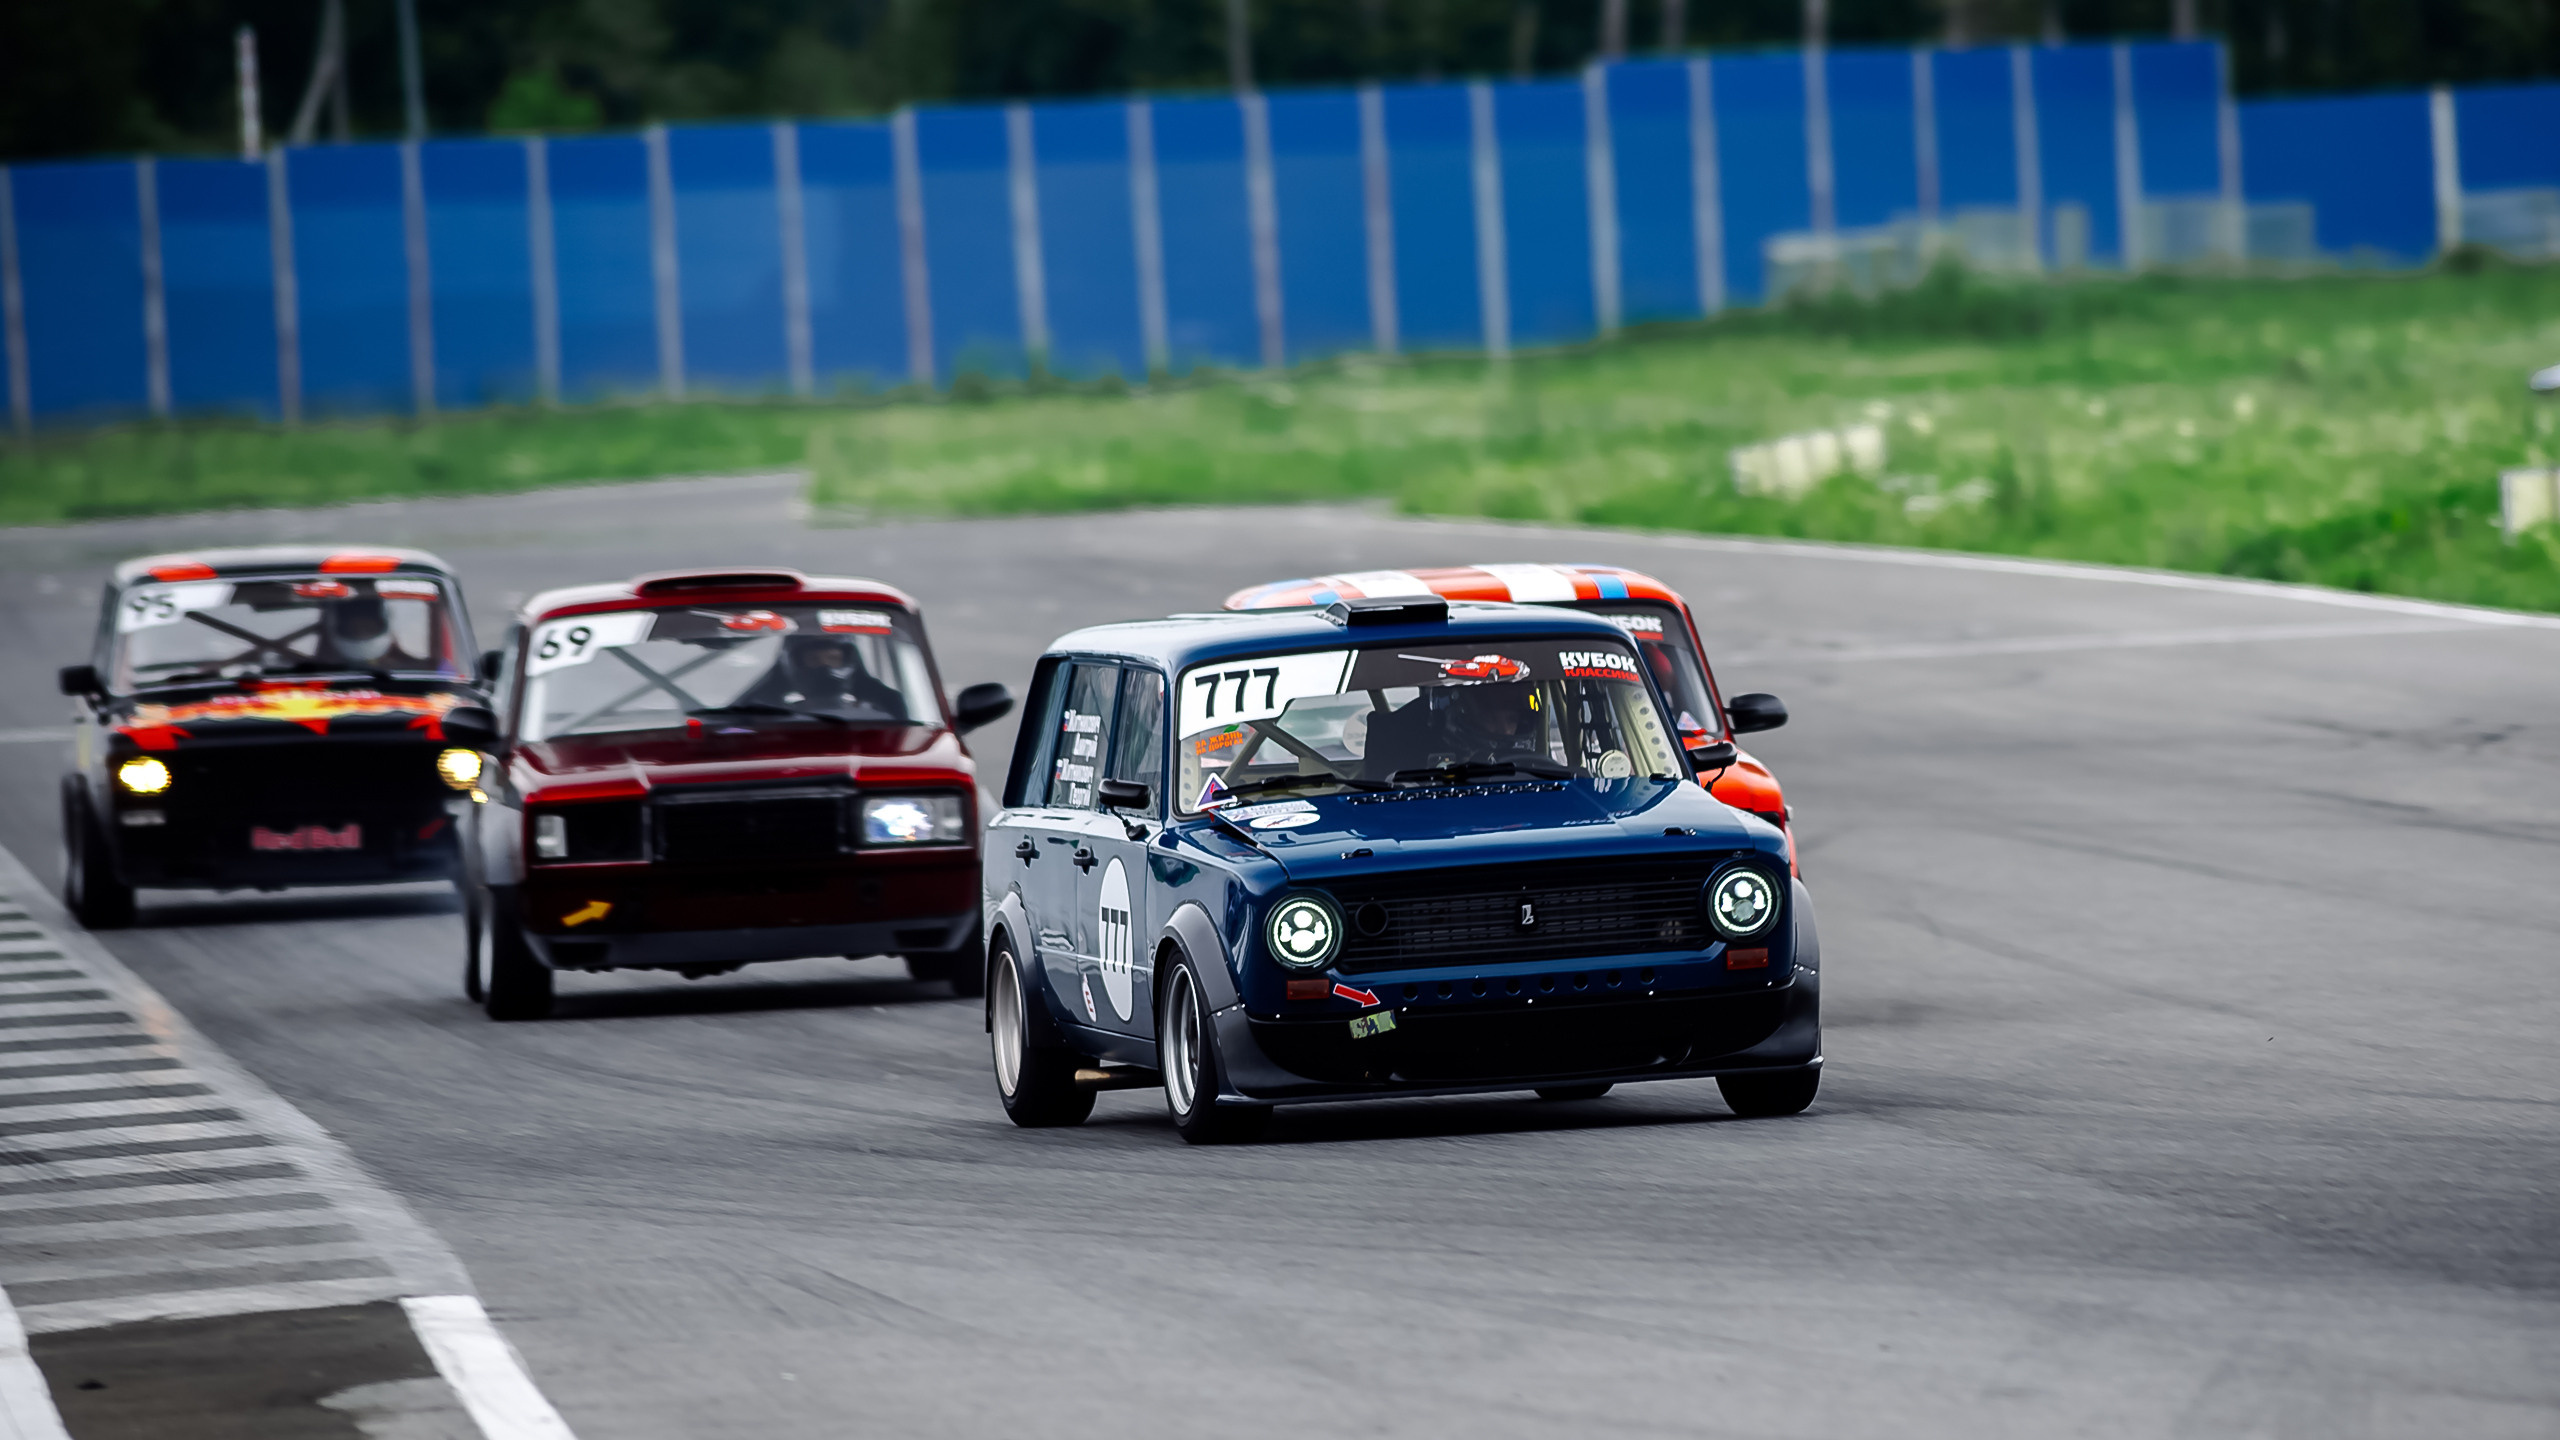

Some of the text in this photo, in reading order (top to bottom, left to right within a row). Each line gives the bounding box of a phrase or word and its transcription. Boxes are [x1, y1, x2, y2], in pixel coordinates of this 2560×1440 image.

[538, 626, 592, 660] 69
[1559, 652, 1637, 672] КУБОК
[1564, 667, 1640, 682] КЛАССИКИ
[1195, 667, 1280, 719] 777
[1101, 906, 1129, 975] 777
